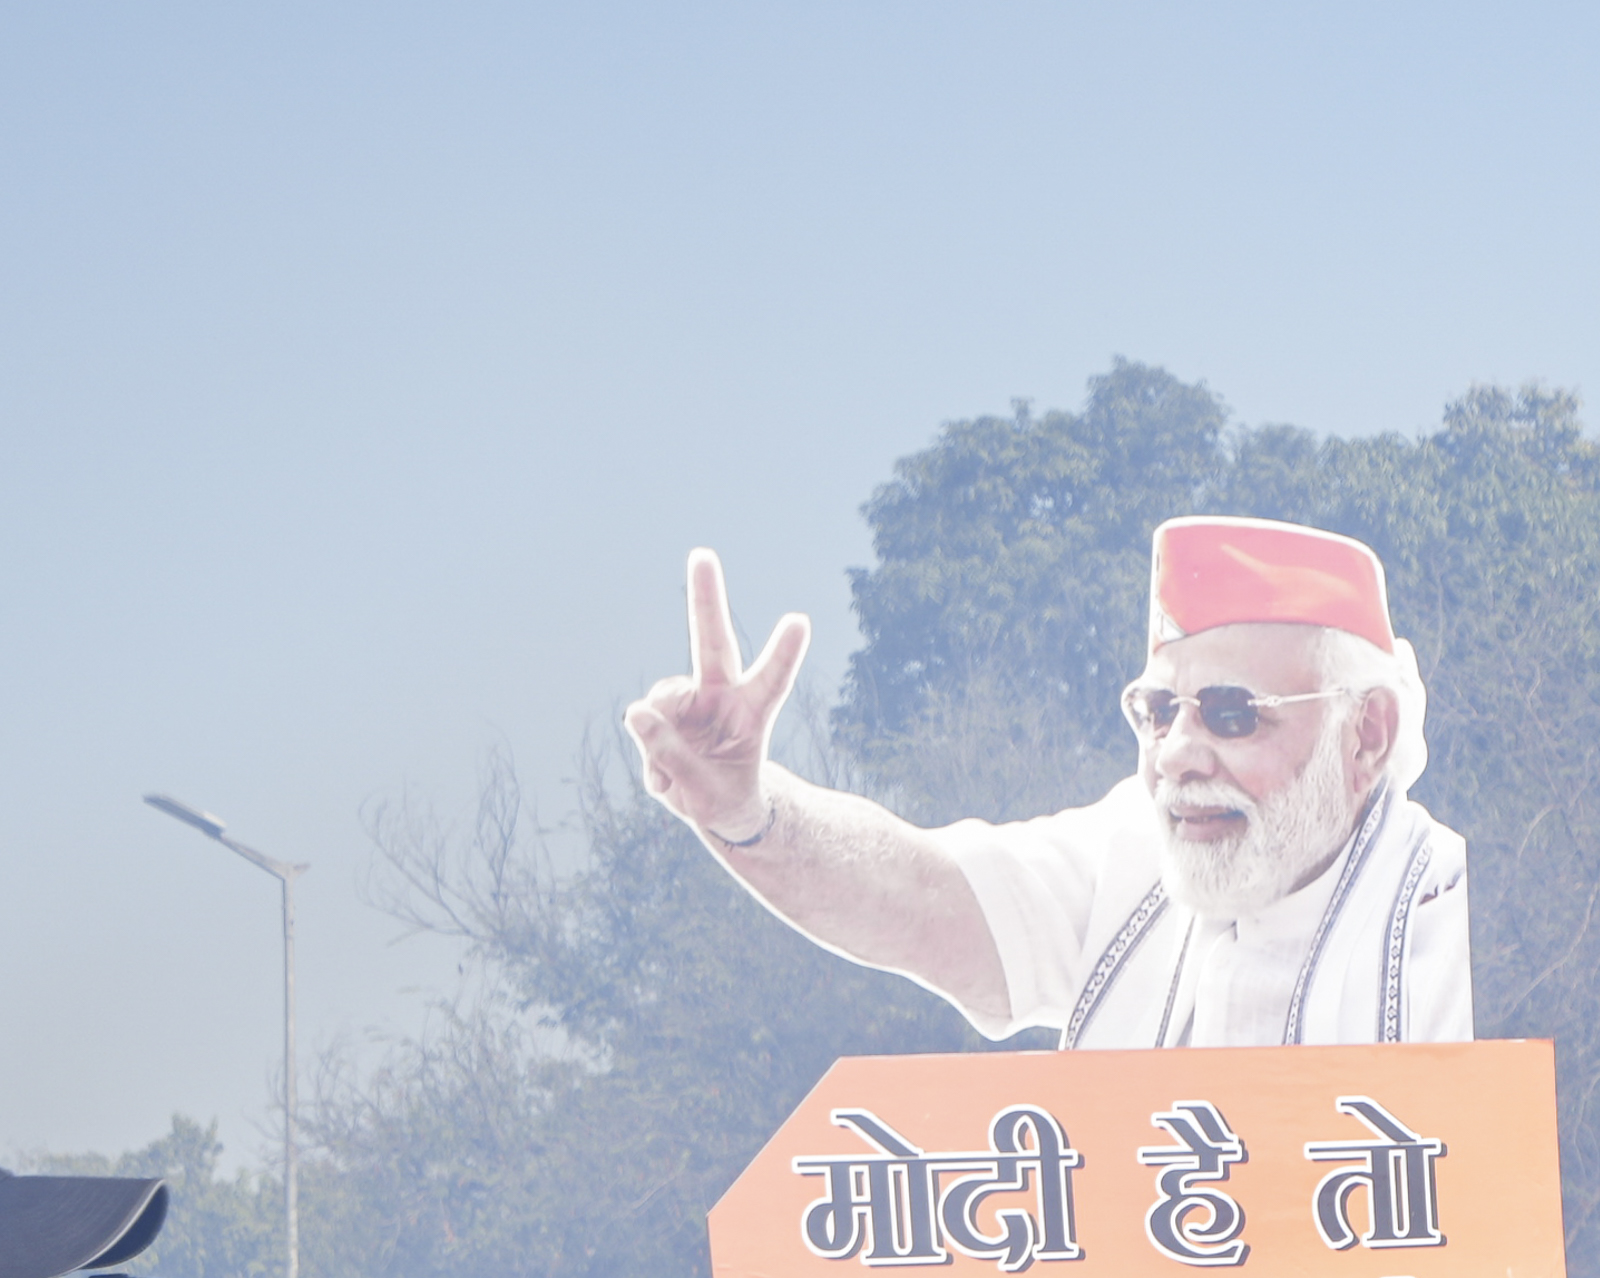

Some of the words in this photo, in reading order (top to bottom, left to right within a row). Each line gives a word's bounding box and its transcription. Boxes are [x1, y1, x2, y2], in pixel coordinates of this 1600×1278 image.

[791, 1102, 1085, 1272] मोदी
[1137, 1100, 1249, 1266] है
[1303, 1095, 1447, 1250] तो
